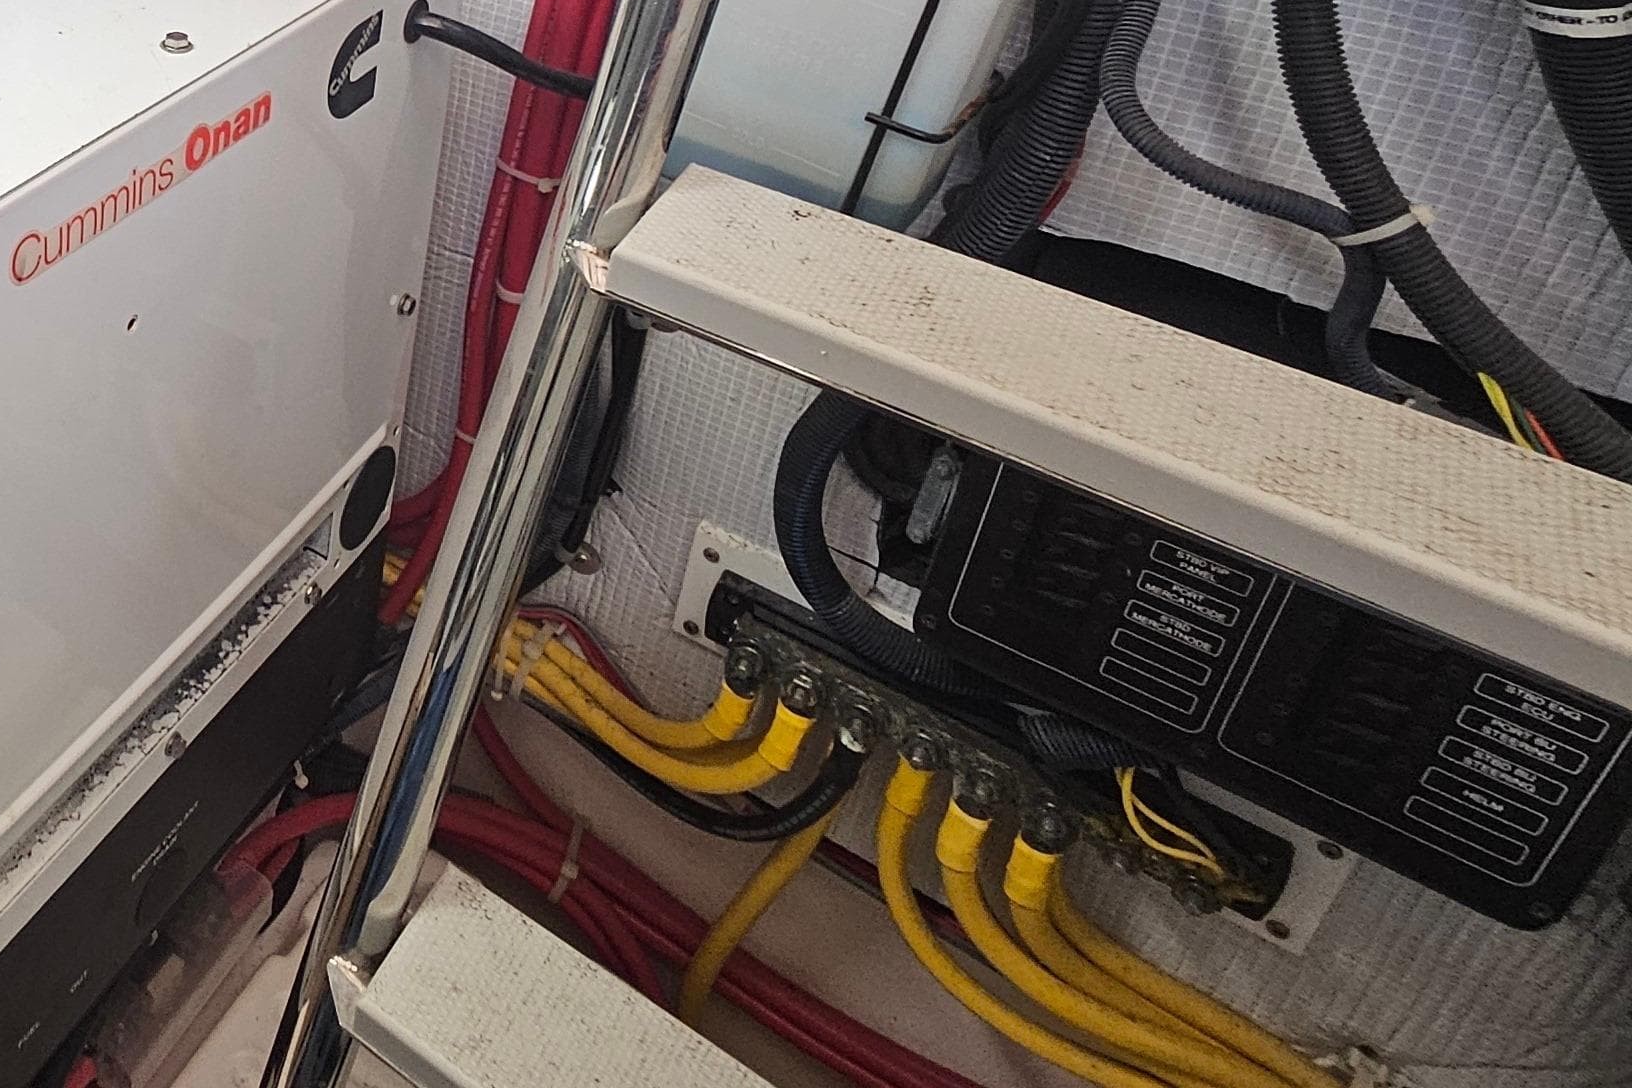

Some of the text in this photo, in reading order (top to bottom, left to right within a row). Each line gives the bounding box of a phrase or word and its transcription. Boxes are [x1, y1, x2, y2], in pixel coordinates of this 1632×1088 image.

[328, 14, 380, 98] Cummins
[11, 94, 273, 284] Cummins Onan
[1175, 550, 1208, 569] STBD
[1178, 561, 1217, 583] PANEL
[1144, 582, 1227, 624] MERCATHODE
[1172, 584, 1205, 602] PORT
[1504, 684, 1546, 707] STBD
[1519, 702, 1555, 722] ECU
[1480, 725, 1557, 763] STEERING
[1462, 757, 1537, 794] STEERING
[1462, 789, 1505, 813] HELM
